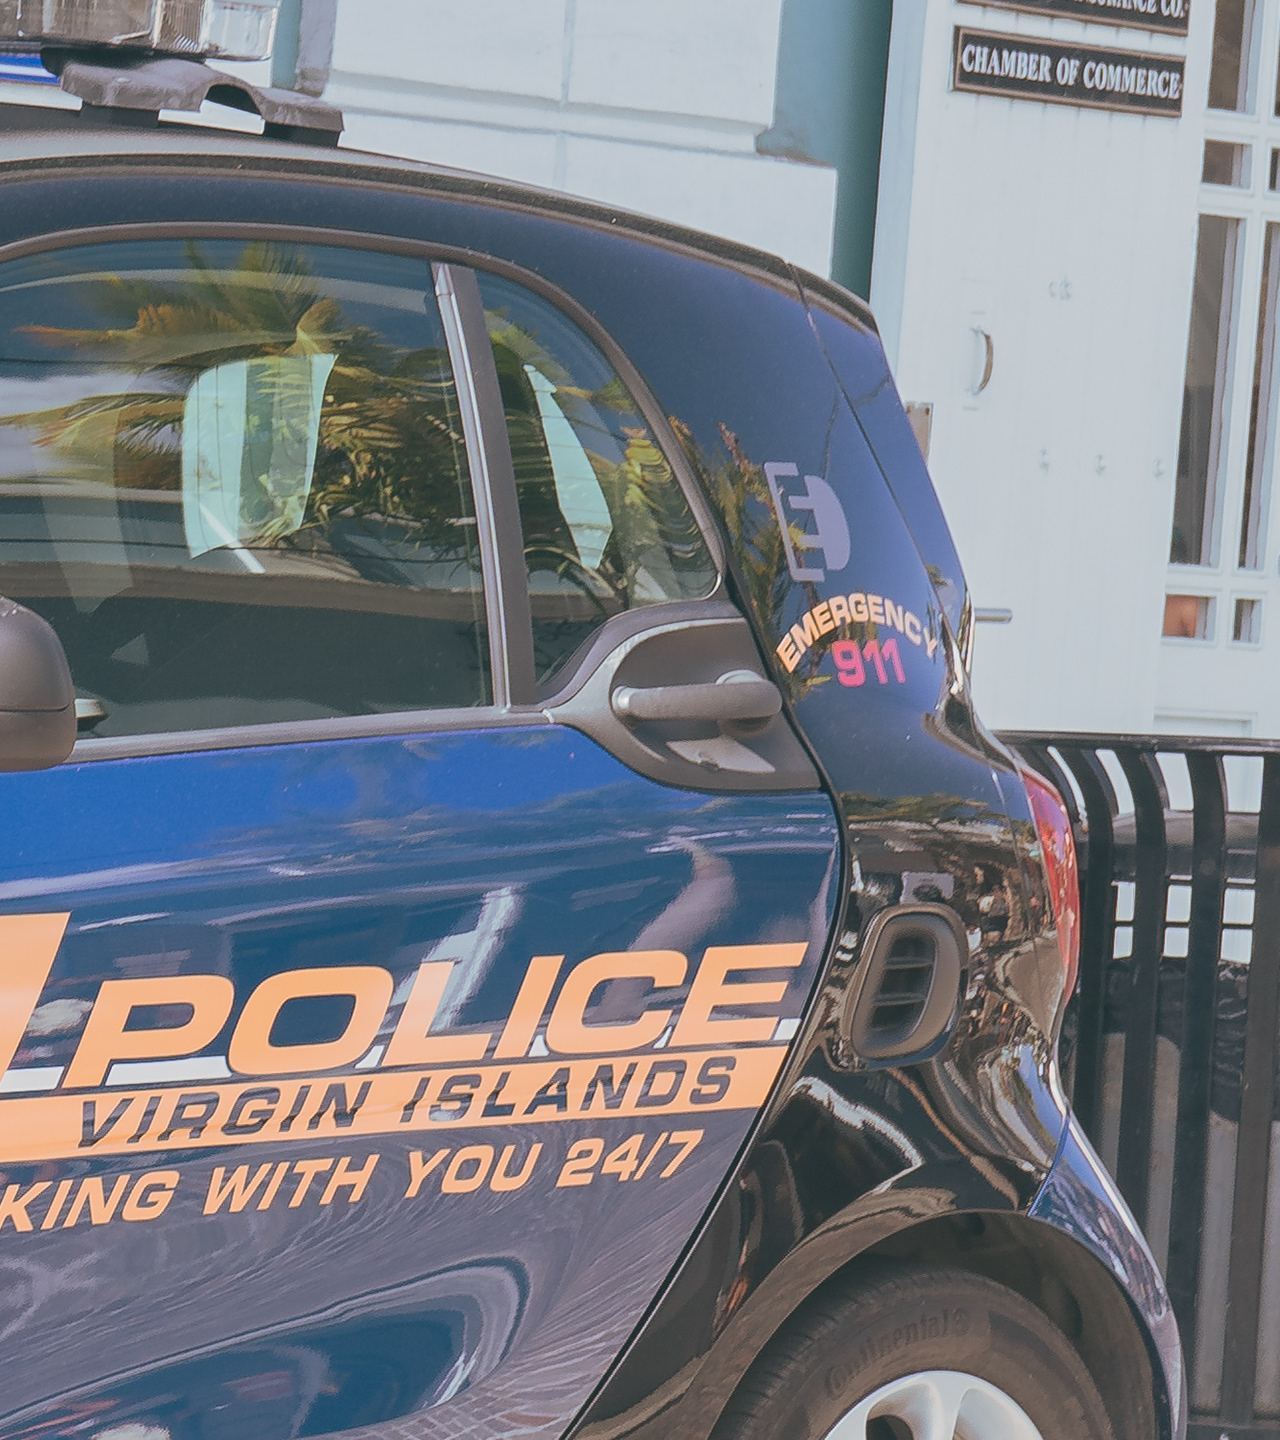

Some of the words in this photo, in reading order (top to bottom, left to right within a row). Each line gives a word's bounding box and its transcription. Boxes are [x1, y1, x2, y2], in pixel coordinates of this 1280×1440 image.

[962, 44, 1051, 83] CHAMBER
[1056, 57, 1080, 87] OF
[1083, 61, 1181, 100] COMMERCE
[776, 592, 938, 673] EMERGENCY
[832, 637, 906, 687] 911
[62, 941, 810, 1089] POLICE
[77, 1081, 368, 1149] VIRGIN
[403, 1056, 736, 1123] ISLANDS
[202, 1152, 387, 1215] WITH
[407, 1140, 550, 1194] YOU
[555, 1129, 705, 1187] 24/7
